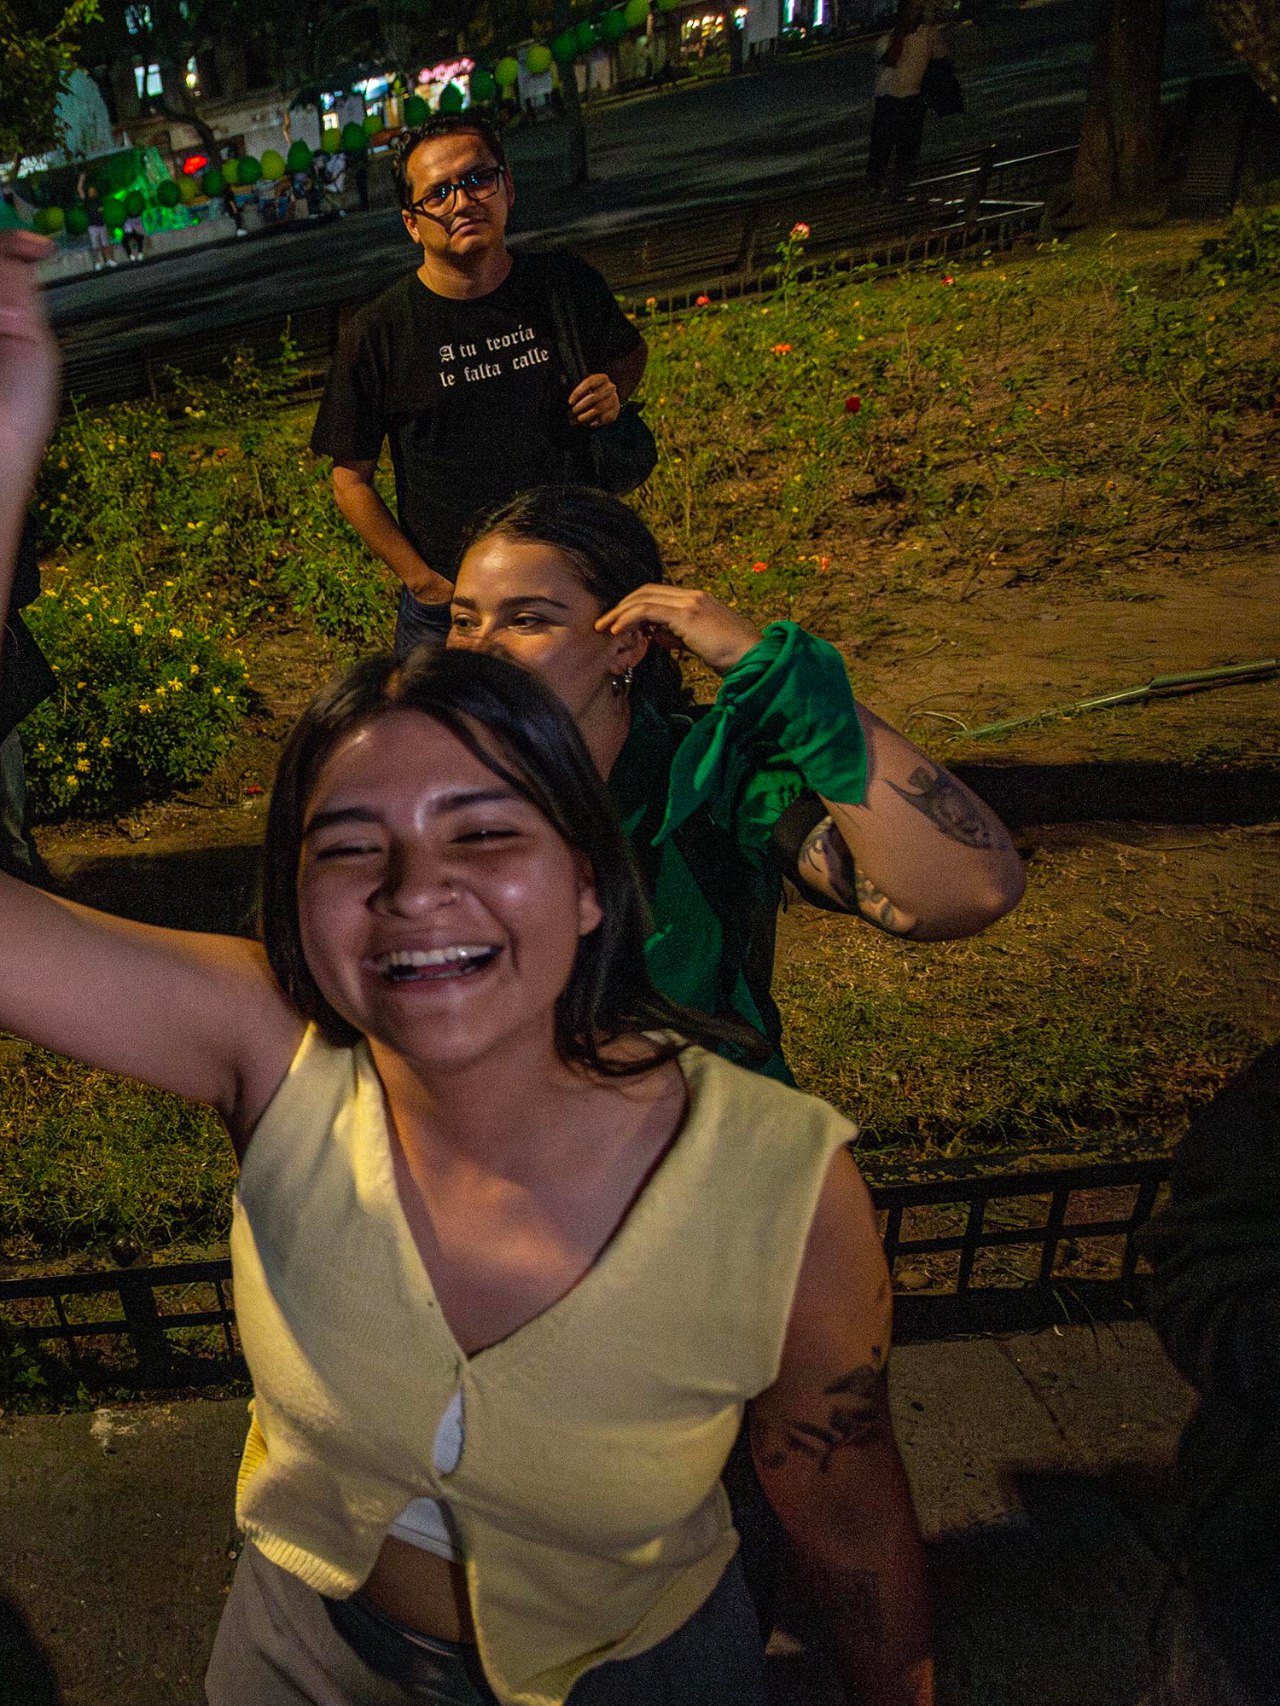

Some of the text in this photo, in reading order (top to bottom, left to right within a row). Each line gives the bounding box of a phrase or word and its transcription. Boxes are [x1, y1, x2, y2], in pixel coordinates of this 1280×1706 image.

[439, 324, 535, 362] A tu teoría
[439, 347, 550, 387] le falta calle
